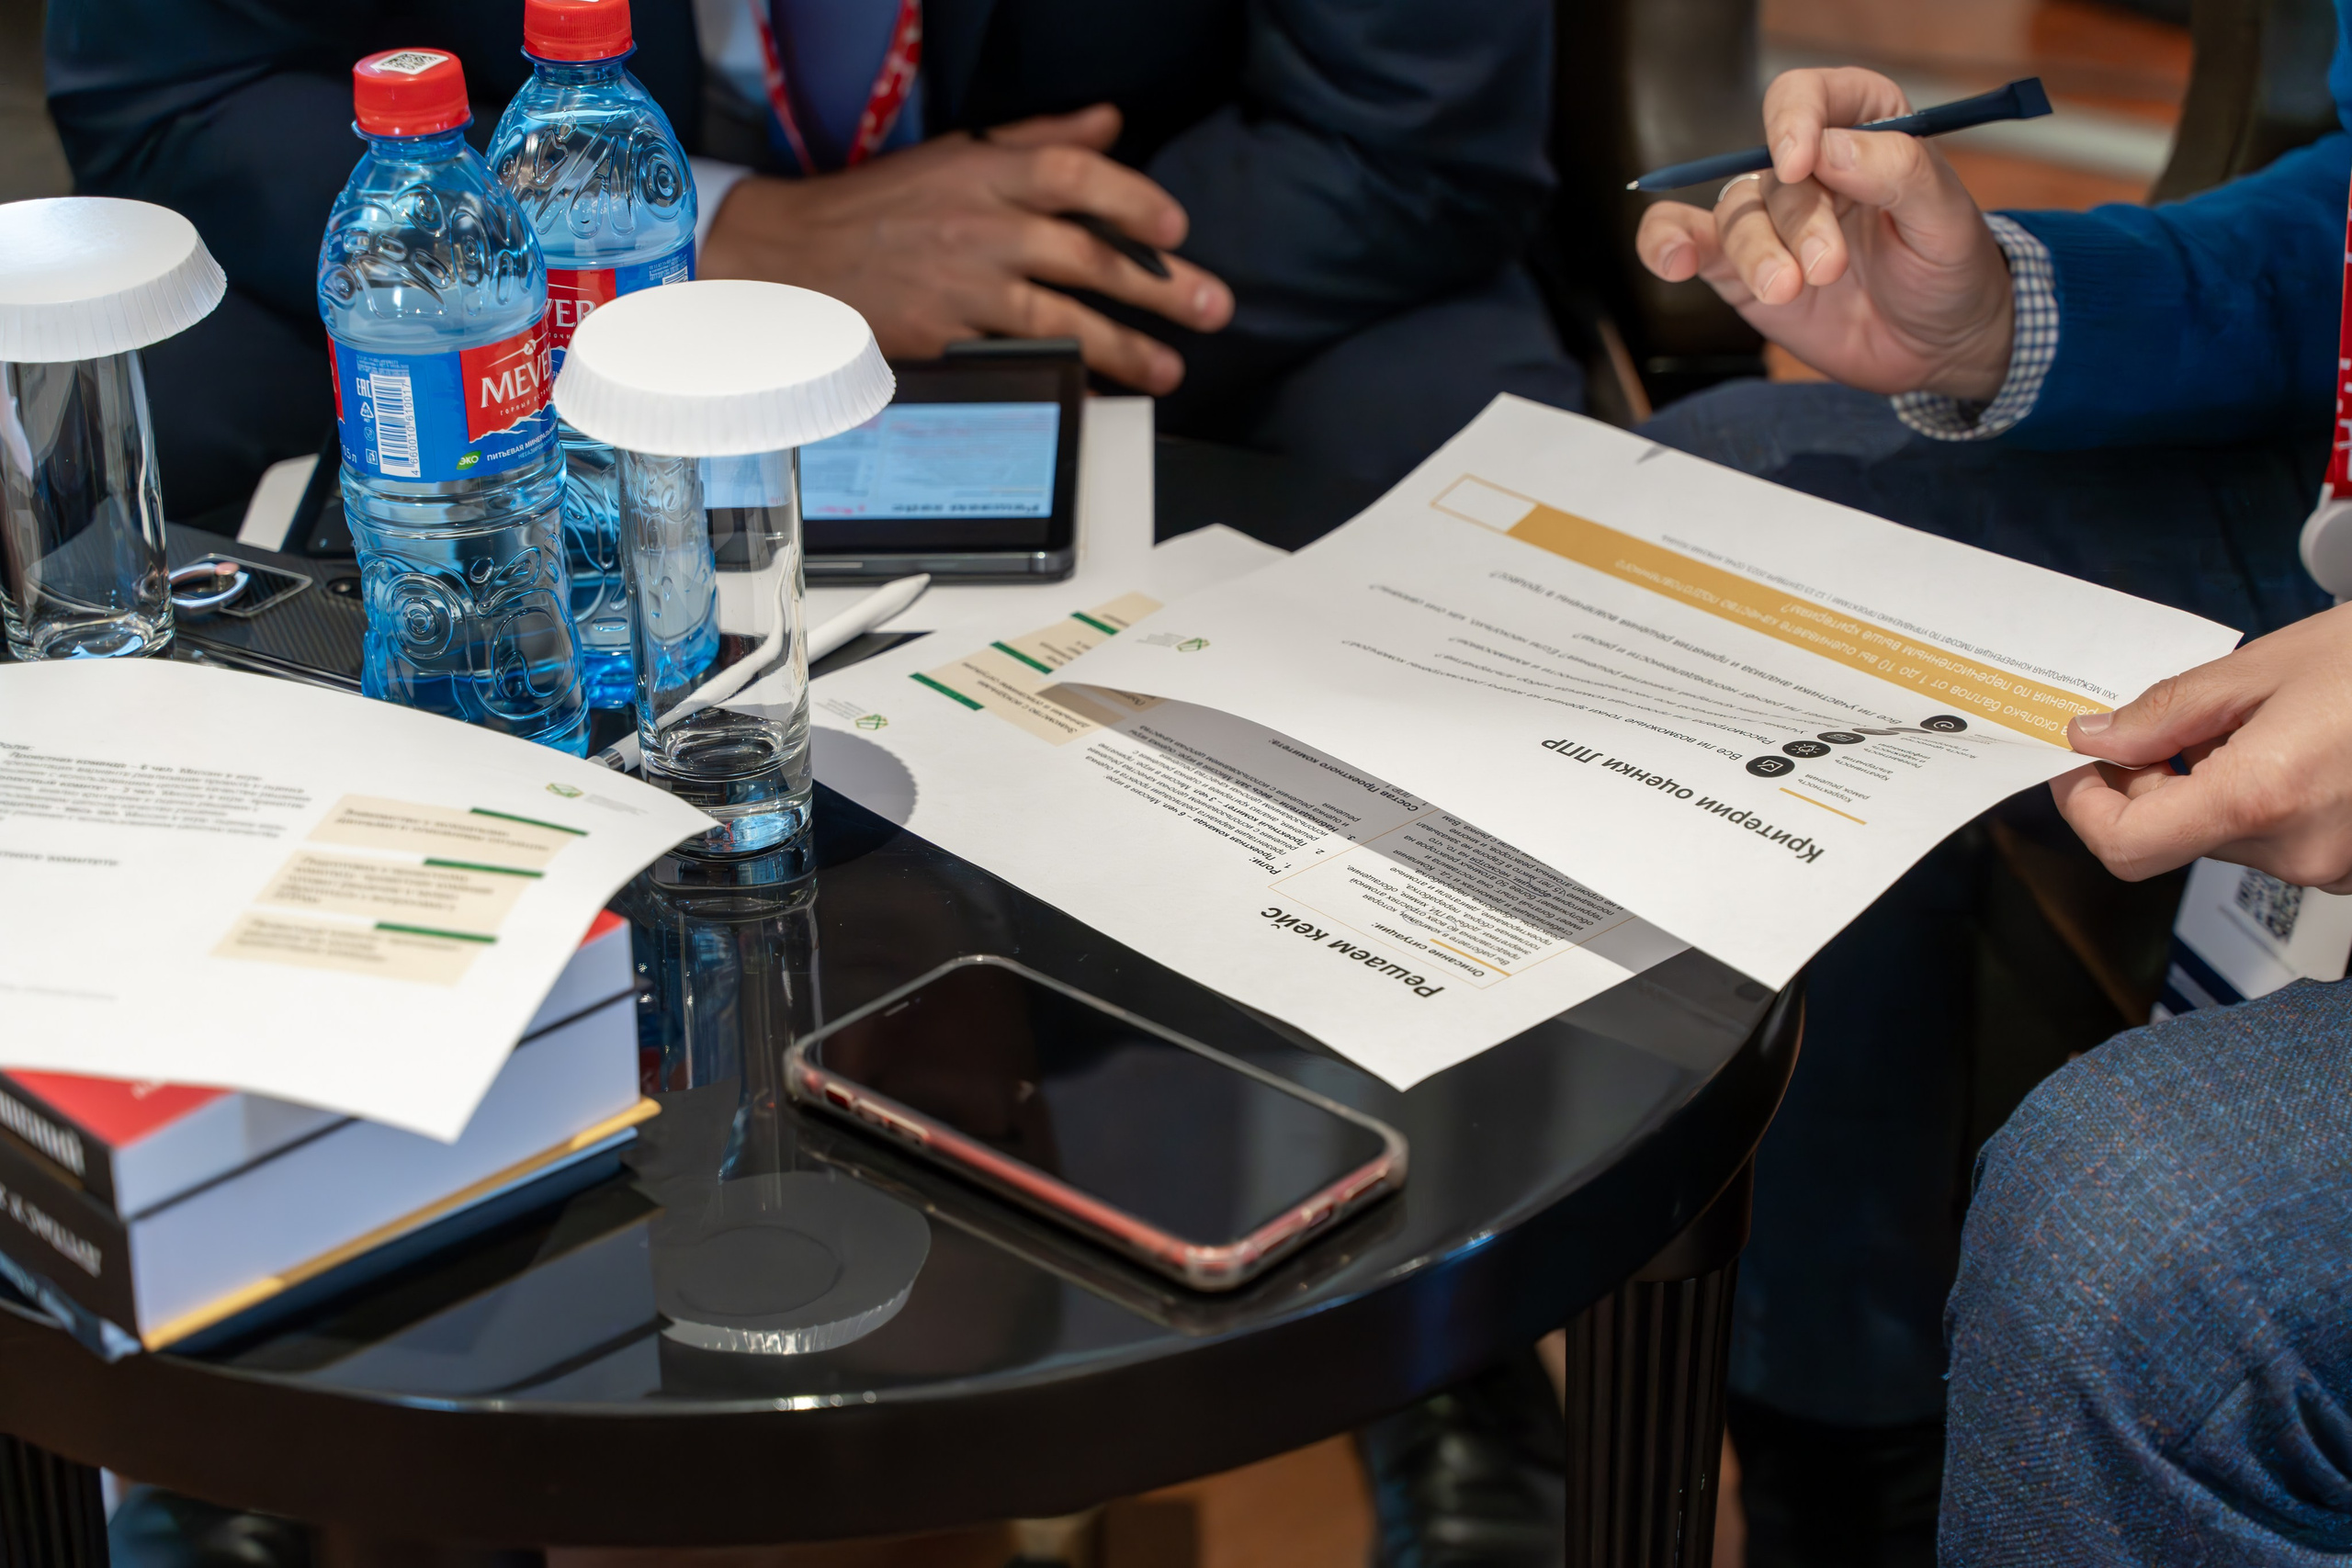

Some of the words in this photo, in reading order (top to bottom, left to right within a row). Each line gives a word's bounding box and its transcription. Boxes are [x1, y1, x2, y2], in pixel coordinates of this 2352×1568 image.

[481, 342, 552, 408] MEVE
[401, 382, 414, 422] 610017
[406, 426, 419, 465] 660010
[487, 444, 526, 461] ПИТЬЕВАЯ
[459, 455, 480, 466] ЭКО
[1860, 629, 1903, 651] выше
[1925, 630, 1942, 640] ПО
[1939, 635, 1974, 652] ПМСОФТ
[1671, 638, 1730, 664] принятия
[1857, 650, 1879, 664] вы
[1973, 646, 2036, 671] КОНФЕРЕНЦИЯ
[1740, 664, 1792, 686] анализа
[1876, 658, 1895, 672] 10
[1898, 665, 1921, 679] до
[1901, 645, 2012, 691] перечисленным
[1917, 674, 1928, 684] 1
[1928, 679, 1949, 690] от
[2030, 665, 2102, 694] МЕЖДУНАРОДНАЯ
[1792, 684, 1860, 710] участники
[1949, 684, 2001, 712] баллов
[2012, 683, 2032, 697] по
[2100, 688, 2119, 701] XXII
[1587, 707, 1623, 720] точки
[1856, 707, 1877, 716] ли
[2031, 690, 2099, 716] решения
[1875, 714, 1902, 724] Все
[2002, 705, 2059, 731] сколько
[1623, 718, 1697, 743] возможные
[1690, 718, 1776, 745] Рассмотрела
[1268, 738, 1319, 763] комитета:
[1540, 739, 1604, 763] ЛПР
[1695, 740, 1717, 750] ли
[1715, 748, 1743, 761] Все
[1834, 759, 1890, 781] Креативность
[1841, 755, 1894, 774] альтернатив
[1234, 778, 1252, 789] зал.
[1318, 761, 1380, 793] Проектного
[1600, 757, 1694, 799] оценки
[1804, 773, 1844, 790] решения
[1129, 786, 1161, 805] Миссия
[1149, 787, 1200, 812] реализации
[1193, 788, 1208, 798] чел.
[1251, 786, 1273, 799] весь
[1274, 789, 1315, 809] решения
[1379, 790, 1419, 811] Состав
[1797, 778, 1852, 803] Корректность
[1843, 787, 1870, 800] рамок
[1161, 801, 1178, 813] чел.
[1187, 795, 1254, 829] использованием
[1222, 803, 1259, 822] комитет
[1248, 806, 1279, 821] анализ
[1278, 800, 1339, 832] Наблюдатели
[1311, 807, 1342, 823] оценка
[1321, 802, 1362, 822] решения
[1192, 817, 1230, 837] команда
[1196, 809, 1236, 830] варианта
[1261, 801, 1329, 837] использованием
[1441, 815, 1462, 827] Вам
[1694, 795, 1825, 863] Критерии
[1257, 820, 1307, 847] Проектный
[1258, 830, 1299, 851] решения
[1279, 819, 1320, 841] решения,
[1403, 834, 1417, 842] на
[1415, 821, 1461, 844] заказывал
[1448, 828, 1480, 844] многие
[1462, 823, 1493, 840] рынка.
[1228, 835, 1276, 861] Проектная
[1233, 828, 1287, 855] презентация
[1414, 840, 1462, 863] реакторов
[1428, 837, 1443, 846] что
[1445, 843, 1457, 852] то,
[1392, 849, 1435, 872] Компания
[1456, 850, 1470, 858] на
[1471, 848, 1505, 866] Европе
[1488, 844, 1536, 869] реакторов,
[1248, 856, 1282, 874] Роли:
[1430, 857, 1476, 881] поставила
[1457, 860, 1498, 880] атомных
[1468, 855, 1511, 877] несмотря
[1510, 866, 1538, 880] никто
[1346, 863, 1398, 892] обогащение,
[1388, 866, 1428, 886] атомные
[1414, 867, 1470, 897] переработка,
[1476, 878, 1494, 889] она
[1494, 878, 1510, 887] 50
[1506, 874, 1552, 897] Франции,
[1532, 866, 1573, 887] атомных
[1535, 878, 1555, 888] лет
[1348, 877, 1387, 897] атомной
[1459, 880, 1506, 904] демонтаж
[1492, 886, 1520, 901] опыт:
[1508, 884, 1537, 900] более
[1570, 885, 1604, 901] строил
[1362, 893, 1397, 912] которая
[1385, 895, 1427, 917] отраслях
[1399, 890, 1429, 908] химия,
[1405, 883, 1462, 913] переработка,
[1433, 887, 1481, 911] двигатели
[1471, 895, 1518, 919] обработка,
[1517, 898, 1555, 919] богатый
[1551, 895, 1603, 920] территории
[1566, 892, 1614, 916] последние
[1603, 899, 1617, 908] не
[1398, 910, 1442, 933] компании,
[1425, 914, 1447, 927] всех
[1462, 911, 1495, 929] сборка,
[1510, 906, 1573, 936] стабилизация
[1534, 897, 1594, 926] обслуживает
[1260, 907, 1329, 942] кейс
[1444, 914, 1482, 932] добыча
[1480, 909, 1553, 945] проектирование,
[1519, 917, 1565, 941] реакторы,
[1554, 916, 1584, 931] имеет
[1370, 921, 1428, 950] ситуации:
[1457, 930, 1521, 960] представлена
[1493, 927, 1541, 951] топливная
[1448, 935, 1497, 958] работаете
[1326, 939, 1444, 998] Решаем
[1427, 948, 1485, 976] Описание
[1493, 955, 1510, 965] Вы
